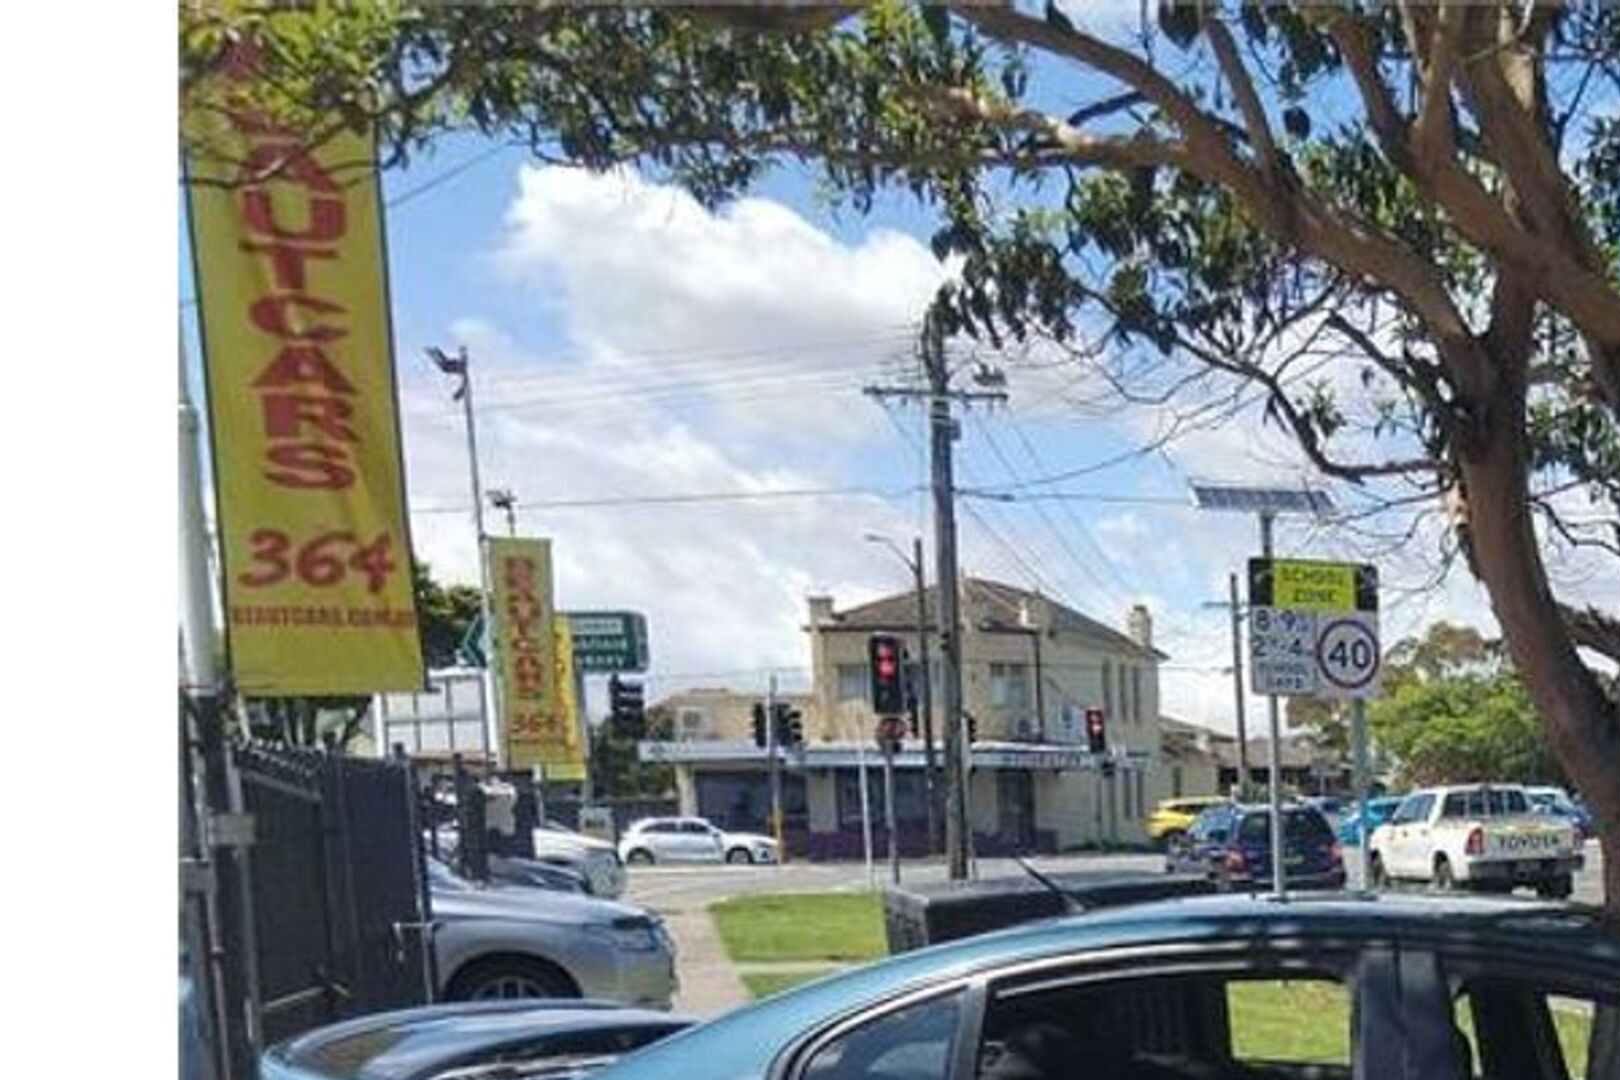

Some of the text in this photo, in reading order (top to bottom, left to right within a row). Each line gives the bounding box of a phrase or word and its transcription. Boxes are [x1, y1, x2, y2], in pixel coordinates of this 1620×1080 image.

[220, 33, 363, 490] AUTCARS
[237, 529, 396, 595] 364
[1328, 640, 1372, 668] 40
